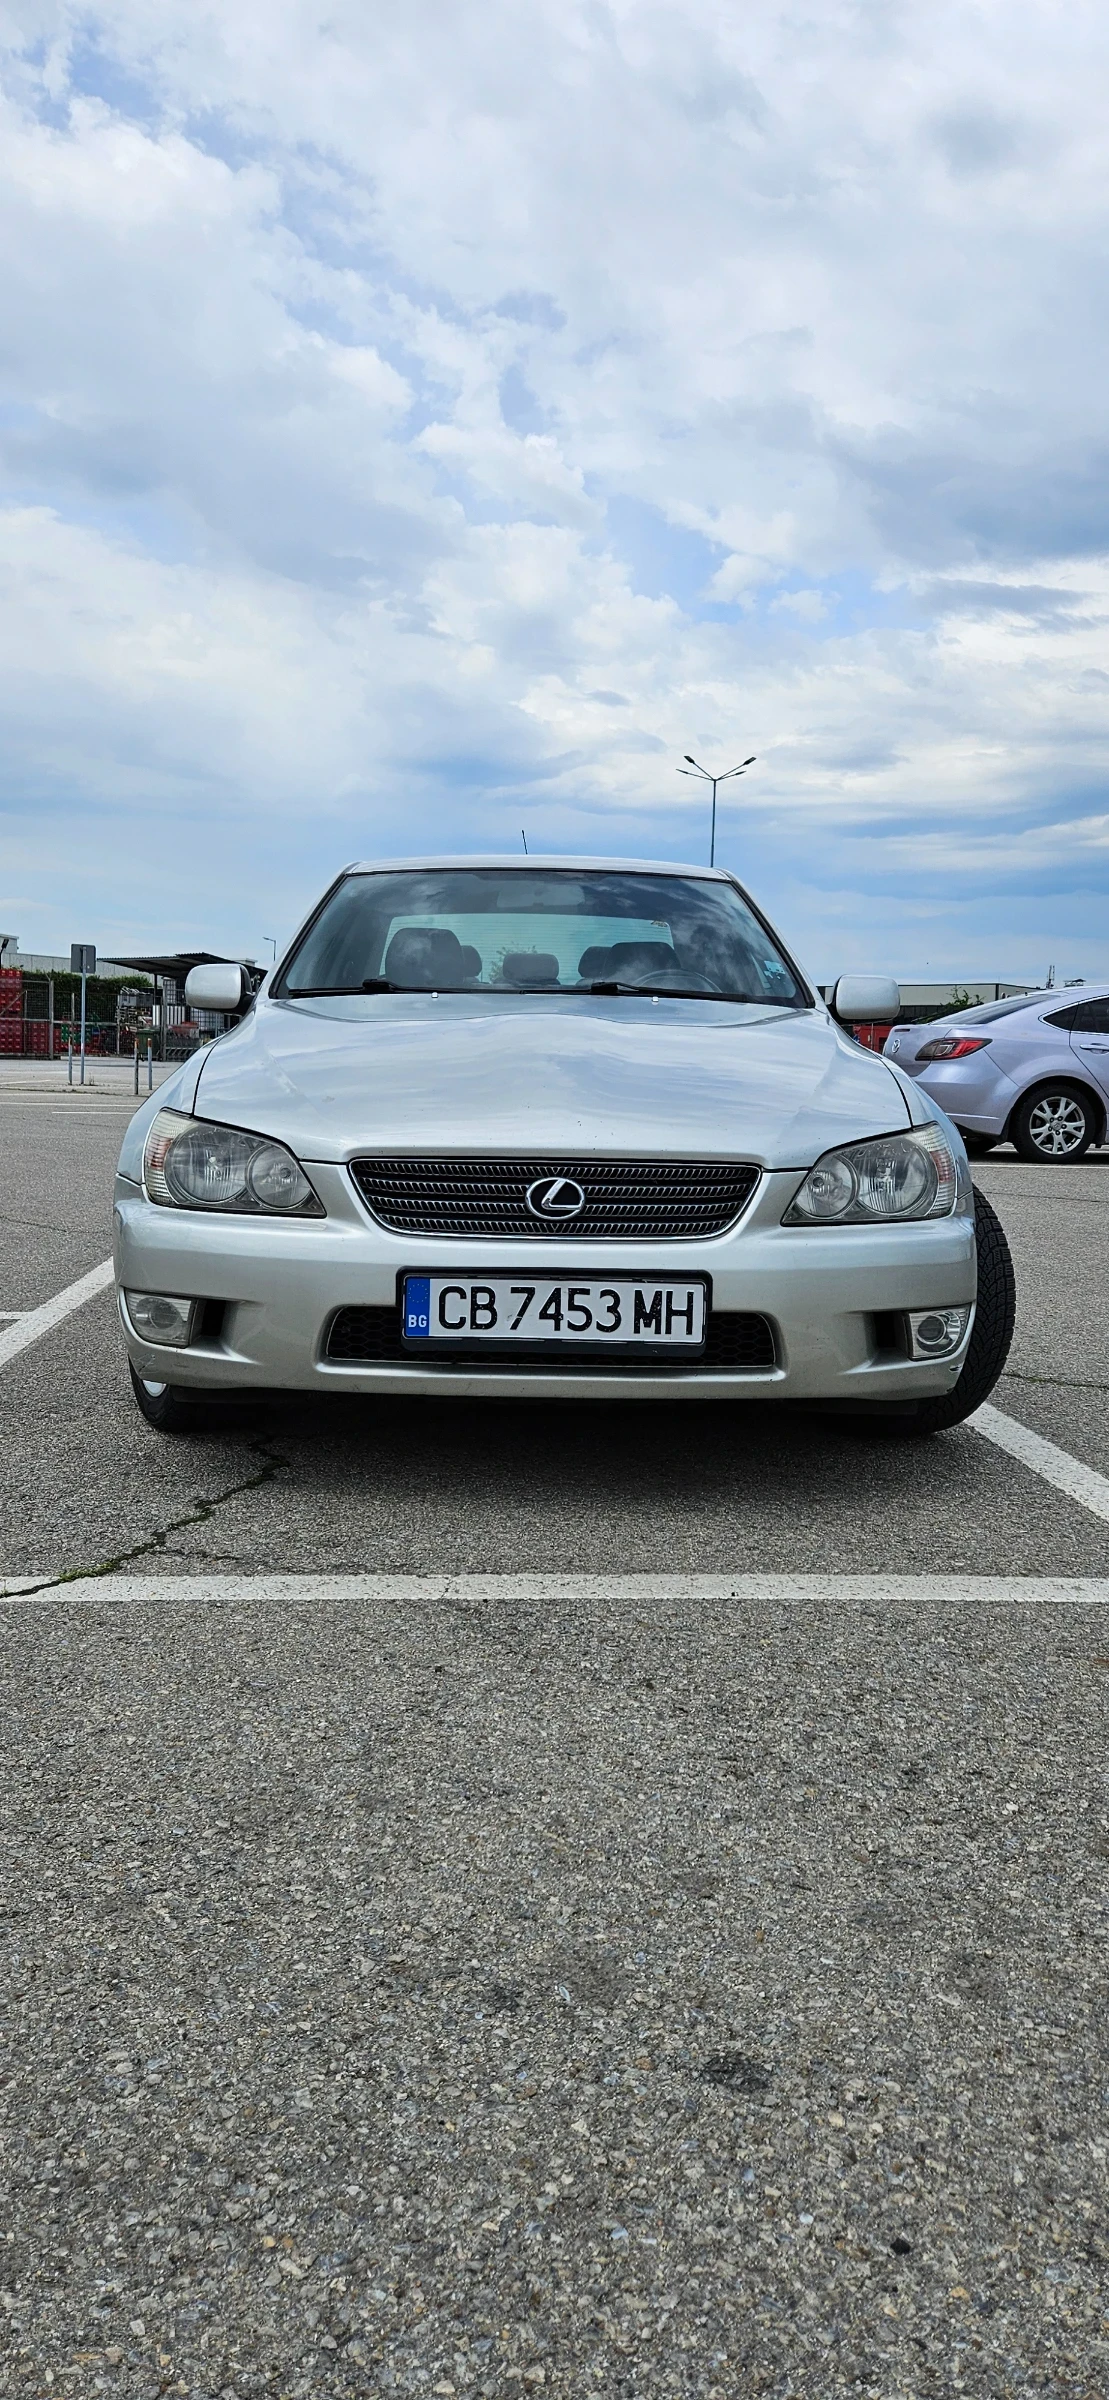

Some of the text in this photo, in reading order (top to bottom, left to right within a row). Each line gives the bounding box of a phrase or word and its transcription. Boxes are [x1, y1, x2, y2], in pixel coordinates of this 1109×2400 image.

[408, 1314, 427, 1328] BG
[438, 1285, 695, 1335] CB 7453 MH
